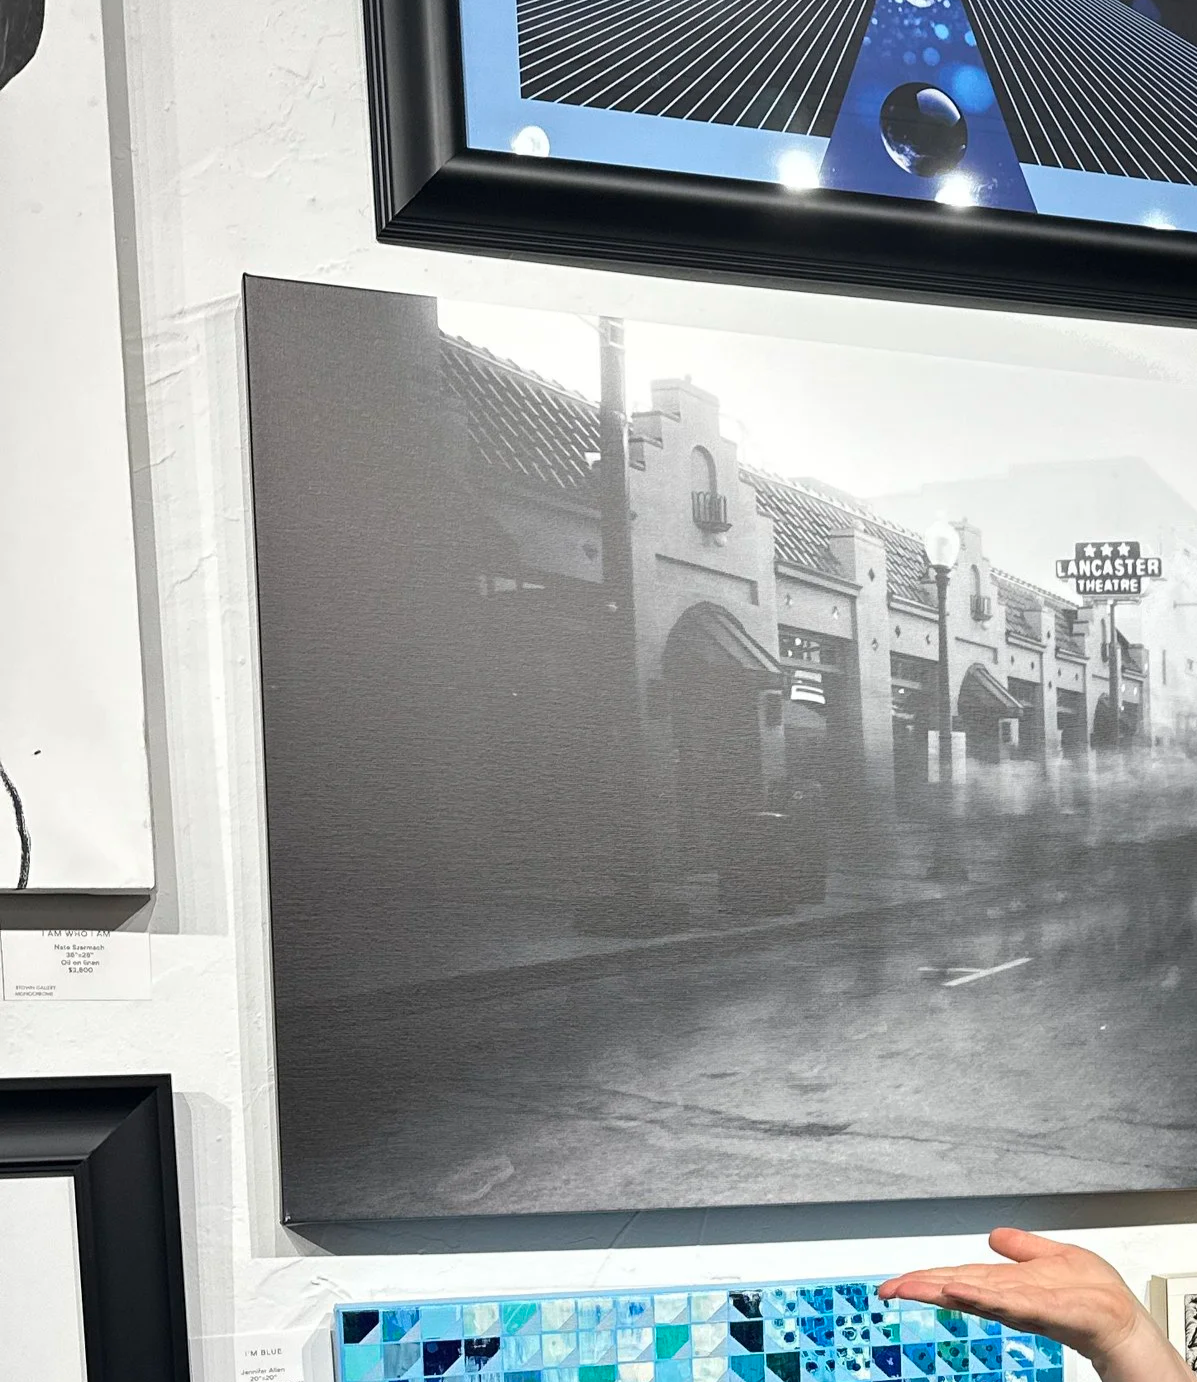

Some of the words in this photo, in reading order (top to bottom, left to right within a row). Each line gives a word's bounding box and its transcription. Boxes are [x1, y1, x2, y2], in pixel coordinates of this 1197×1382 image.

[1056, 558, 1160, 578] LANCASTER
[1077, 578, 1139, 593] THEATRE
[96, 930, 111, 938] AM
[260, 1348, 283, 1356] BLUE
